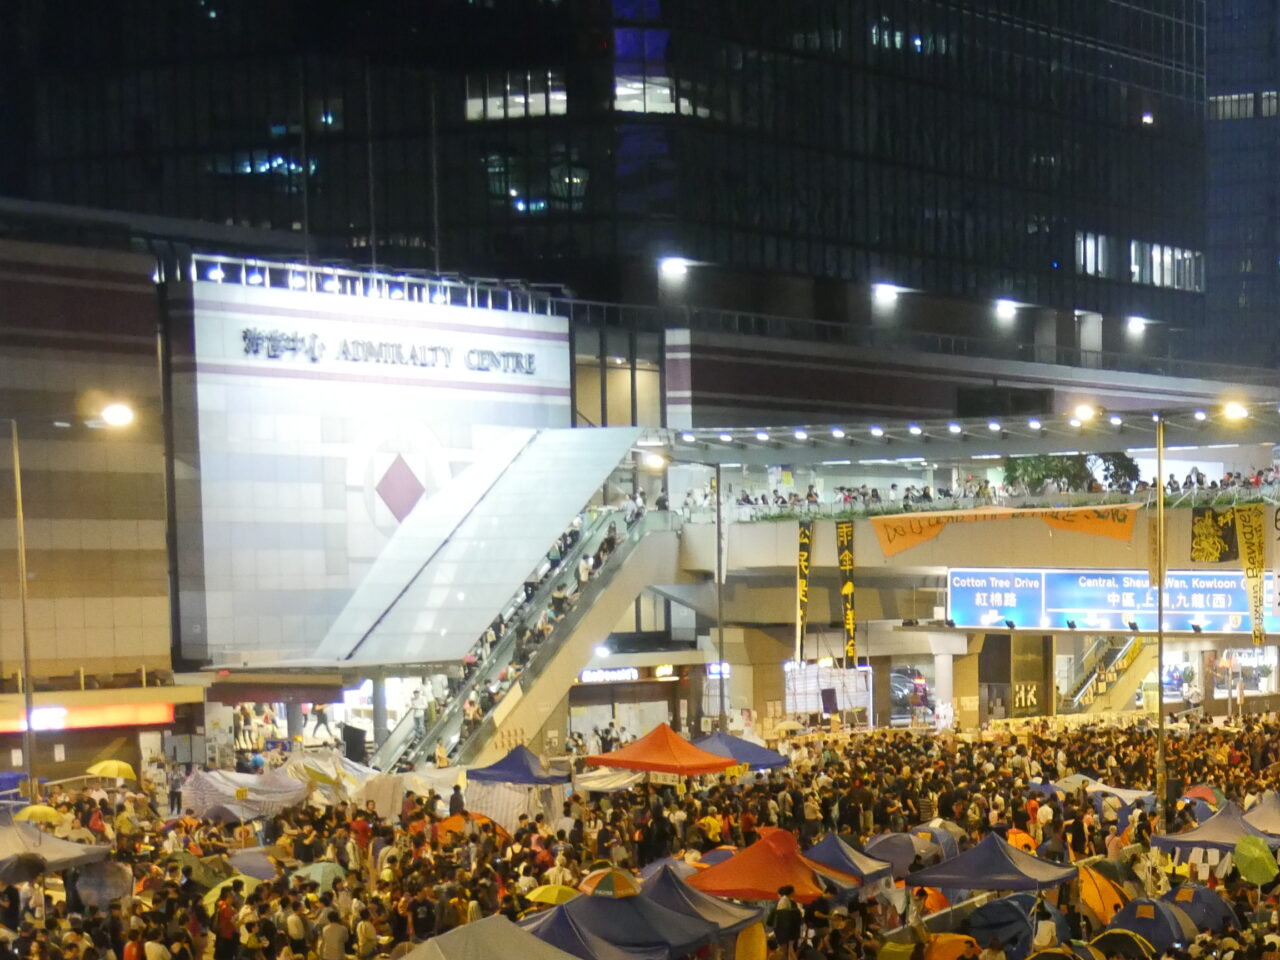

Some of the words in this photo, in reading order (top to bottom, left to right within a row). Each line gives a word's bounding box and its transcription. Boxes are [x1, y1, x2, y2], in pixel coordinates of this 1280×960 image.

[337, 339, 453, 367] ADMIRALTY
[466, 349, 536, 375] CENTRE
[1236, 507, 1258, 579] Beware!
[953, 576, 987, 588] Cotton
[990, 577, 1010, 588] Tree
[1014, 577, 1040, 589] Drive
[1192, 576, 1239, 589] Kowloon
[975, 592, 1017, 608] 紅棉路
